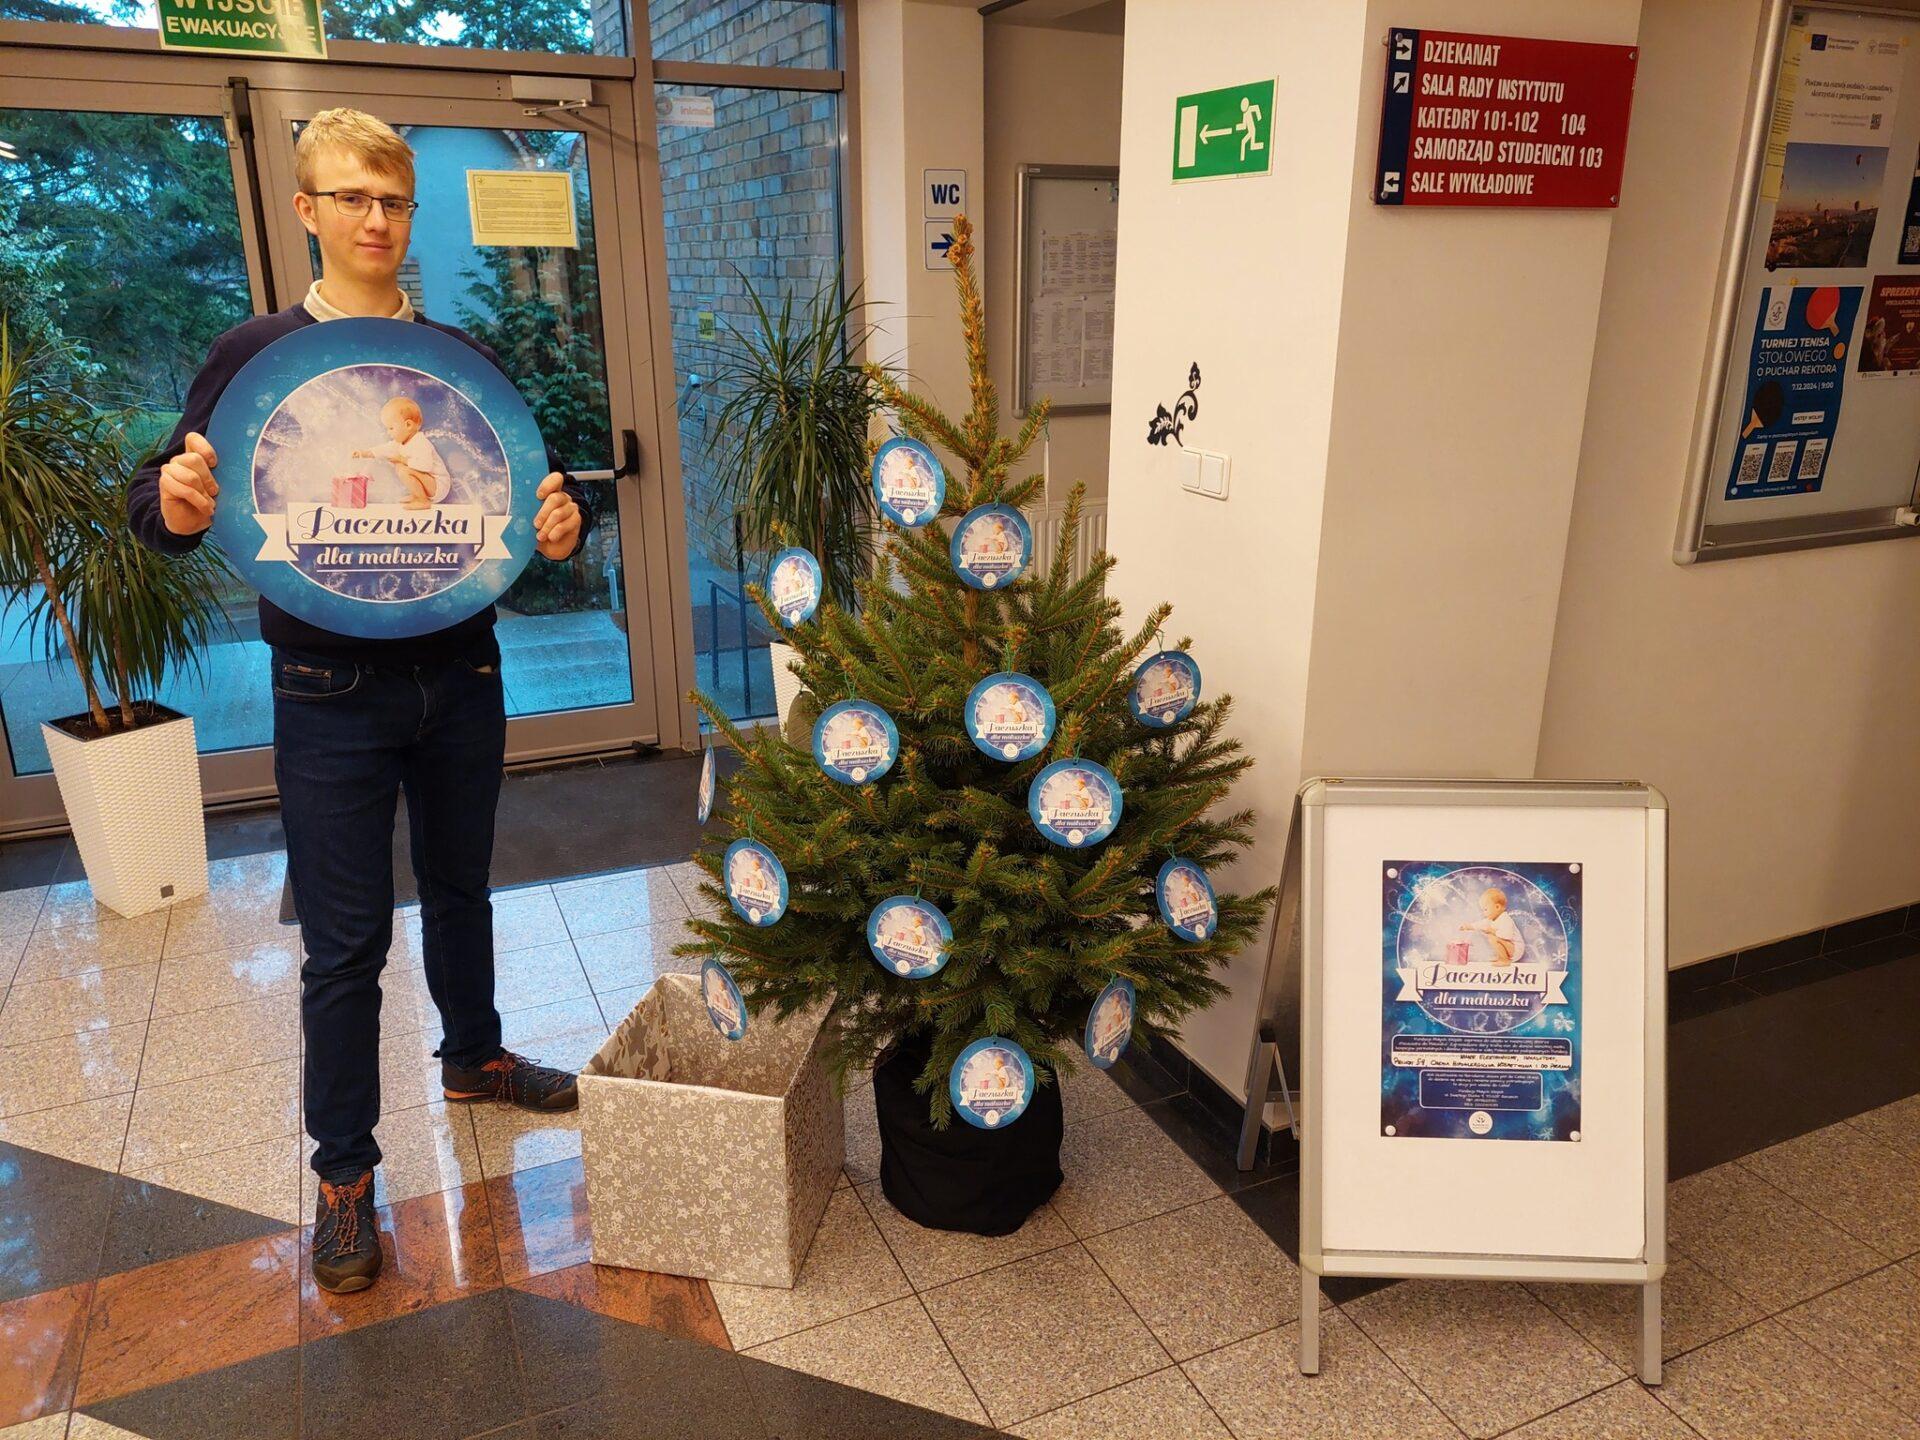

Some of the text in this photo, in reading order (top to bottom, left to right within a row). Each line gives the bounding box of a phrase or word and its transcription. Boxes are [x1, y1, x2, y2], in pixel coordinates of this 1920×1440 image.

[1423, 40, 1501, 67] DZIEKANAT
[1421, 73, 1565, 103] SALA RADY INSTYTUTU
[1417, 106, 1586, 136] KATEDRY 101-102 104
[1414, 136, 1603, 169] SAMORZĄD STUDENCKI 103
[931, 183, 960, 205] WC
[1411, 171, 1534, 195] SALE WYKŁADOWE
[1760, 336, 1830, 349] TURNIEJ TENISA
[1758, 349, 1828, 364] STOŁOWEGO
[1756, 363, 1837, 377] O PUCHAR REKTORA
[297, 506, 469, 541] Paczuszka
[316, 546, 459, 565] dla maluszka
[1423, 963, 1537, 987] Paczuszka
[1434, 992, 1529, 1007] dla maluszka
